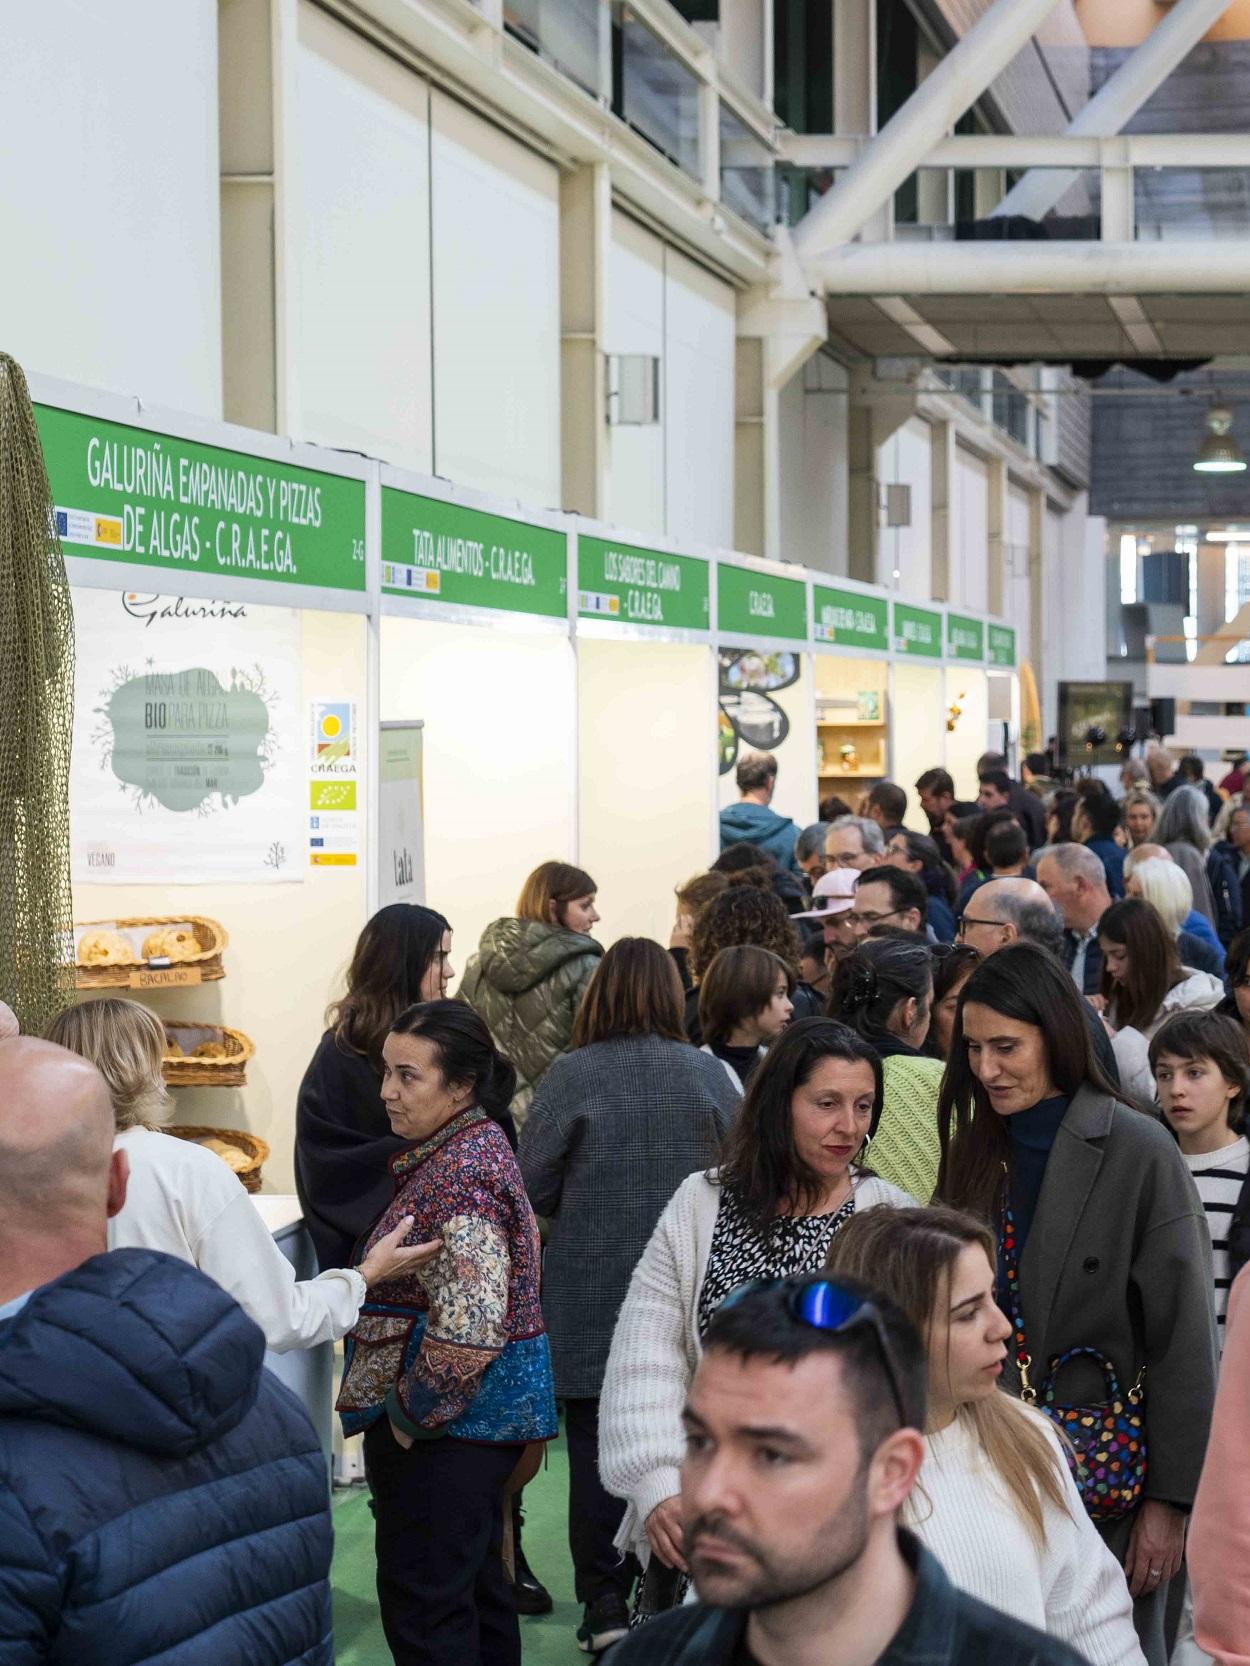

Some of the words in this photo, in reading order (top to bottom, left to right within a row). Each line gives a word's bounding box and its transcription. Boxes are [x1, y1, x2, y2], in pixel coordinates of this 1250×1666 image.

[87, 437, 174, 500] GALURIÑA
[179, 458, 264, 518] EMPANADAS
[267, 478, 277, 519] Y
[279, 480, 321, 528] PIZZAS
[123, 504, 145, 553] DE
[150, 510, 200, 562] ALGAS
[215, 520, 297, 574] C.R.A.E.GA.
[413, 528, 435, 567] TATA
[436, 535, 484, 577] ALIMENTOS
[490, 546, 535, 586] C.R.A.E.GA.
[145, 702, 167, 729] BIO
